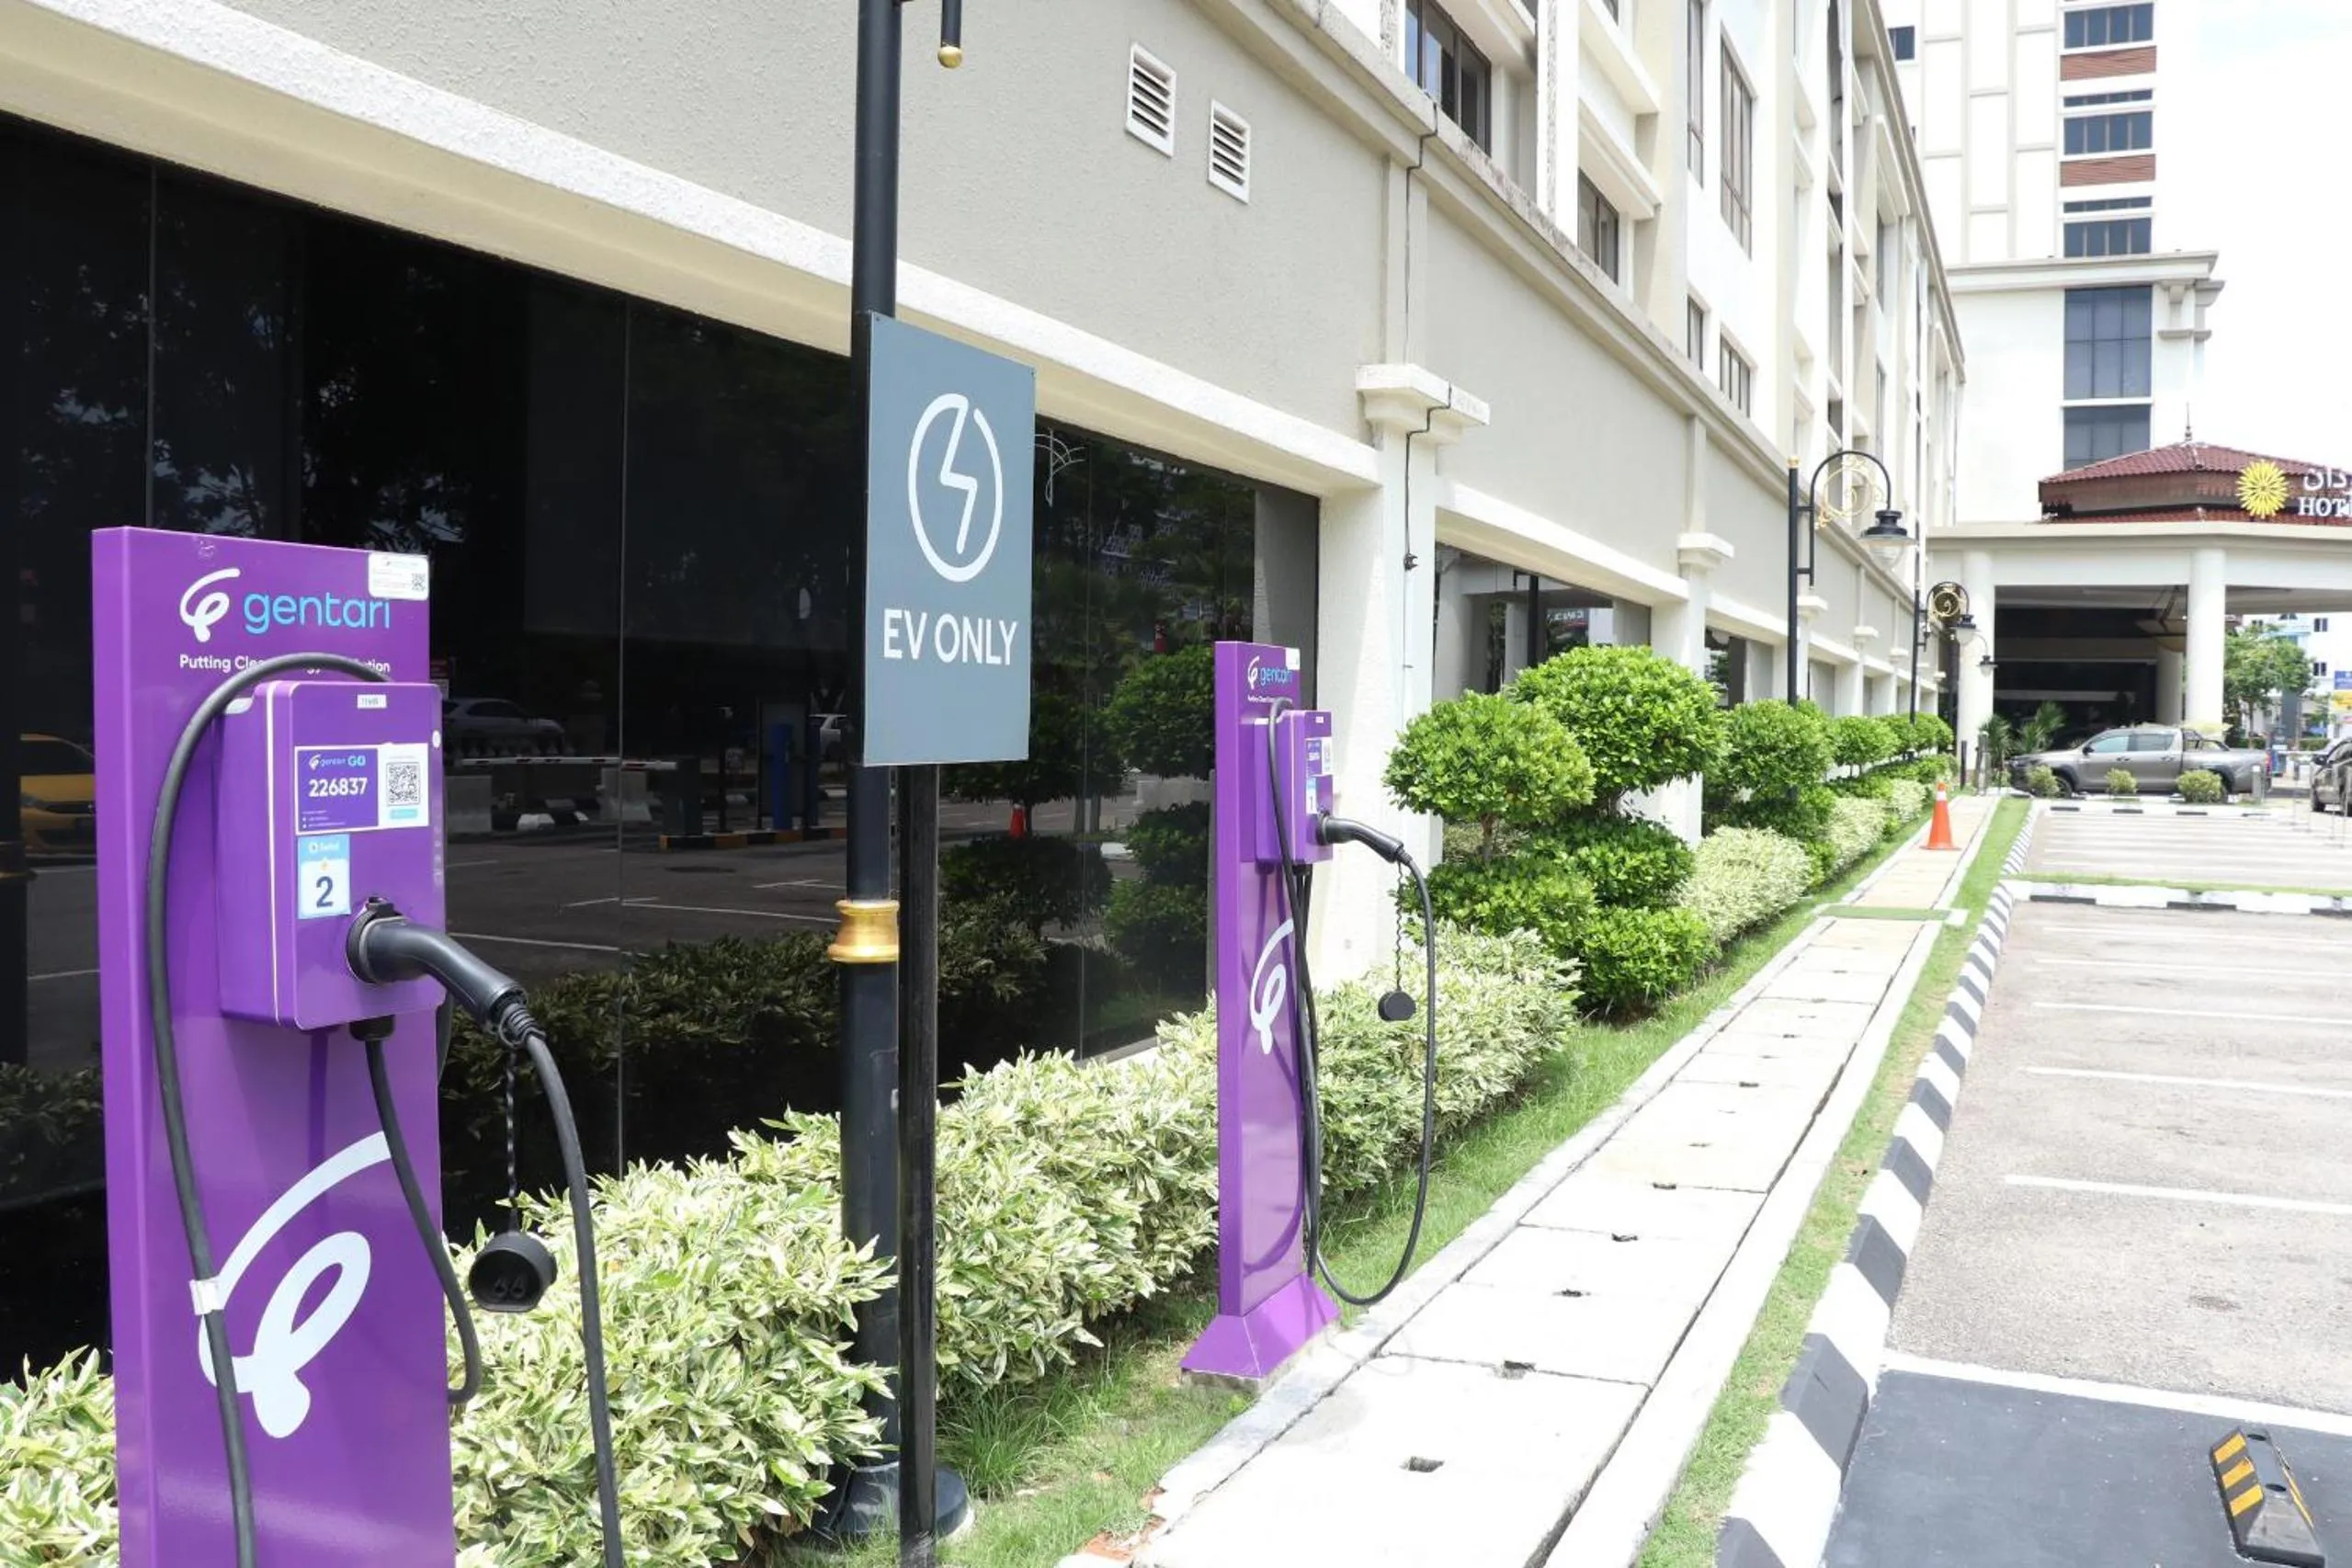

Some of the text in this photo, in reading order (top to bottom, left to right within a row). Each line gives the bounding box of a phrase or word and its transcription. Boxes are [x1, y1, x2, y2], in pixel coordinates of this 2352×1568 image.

[244, 592, 390, 634] gentari
[883, 608, 1018, 665] EV ONLY
[179, 653, 232, 673] Putting
[309, 777, 368, 797] 226837
[315, 875, 334, 909] 2
